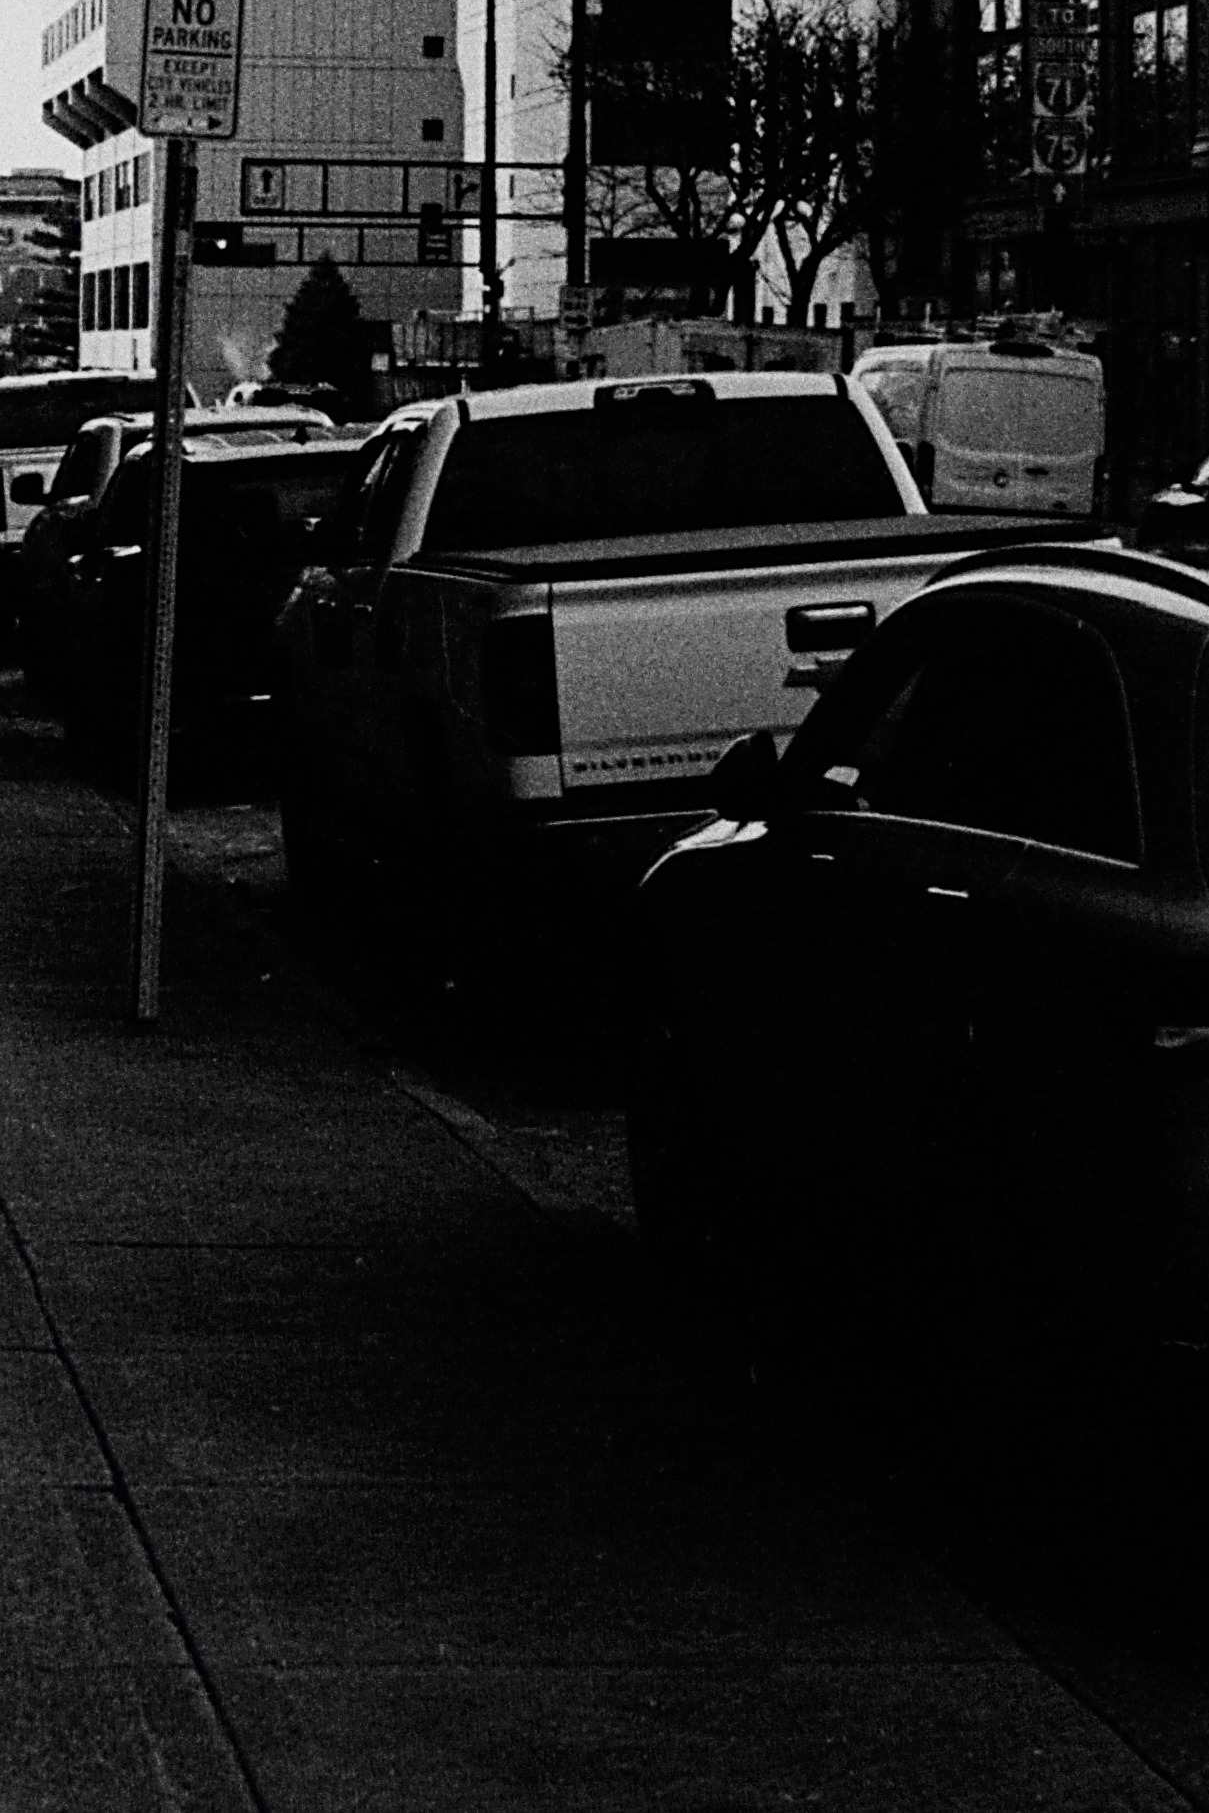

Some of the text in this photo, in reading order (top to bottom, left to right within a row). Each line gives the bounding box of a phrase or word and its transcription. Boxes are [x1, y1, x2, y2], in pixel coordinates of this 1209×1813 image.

[1047, 8, 1075, 24] TO
[153, 27, 231, 49] PARKING
[163, 59, 216, 76] EXCEPT
[148, 93, 158, 108] 2
[193, 97, 228, 111] LIMIT
[1046, 79, 1071, 106] 71
[1047, 136, 1077, 165] 75
[573, 750, 721, 773] SILVERADO
